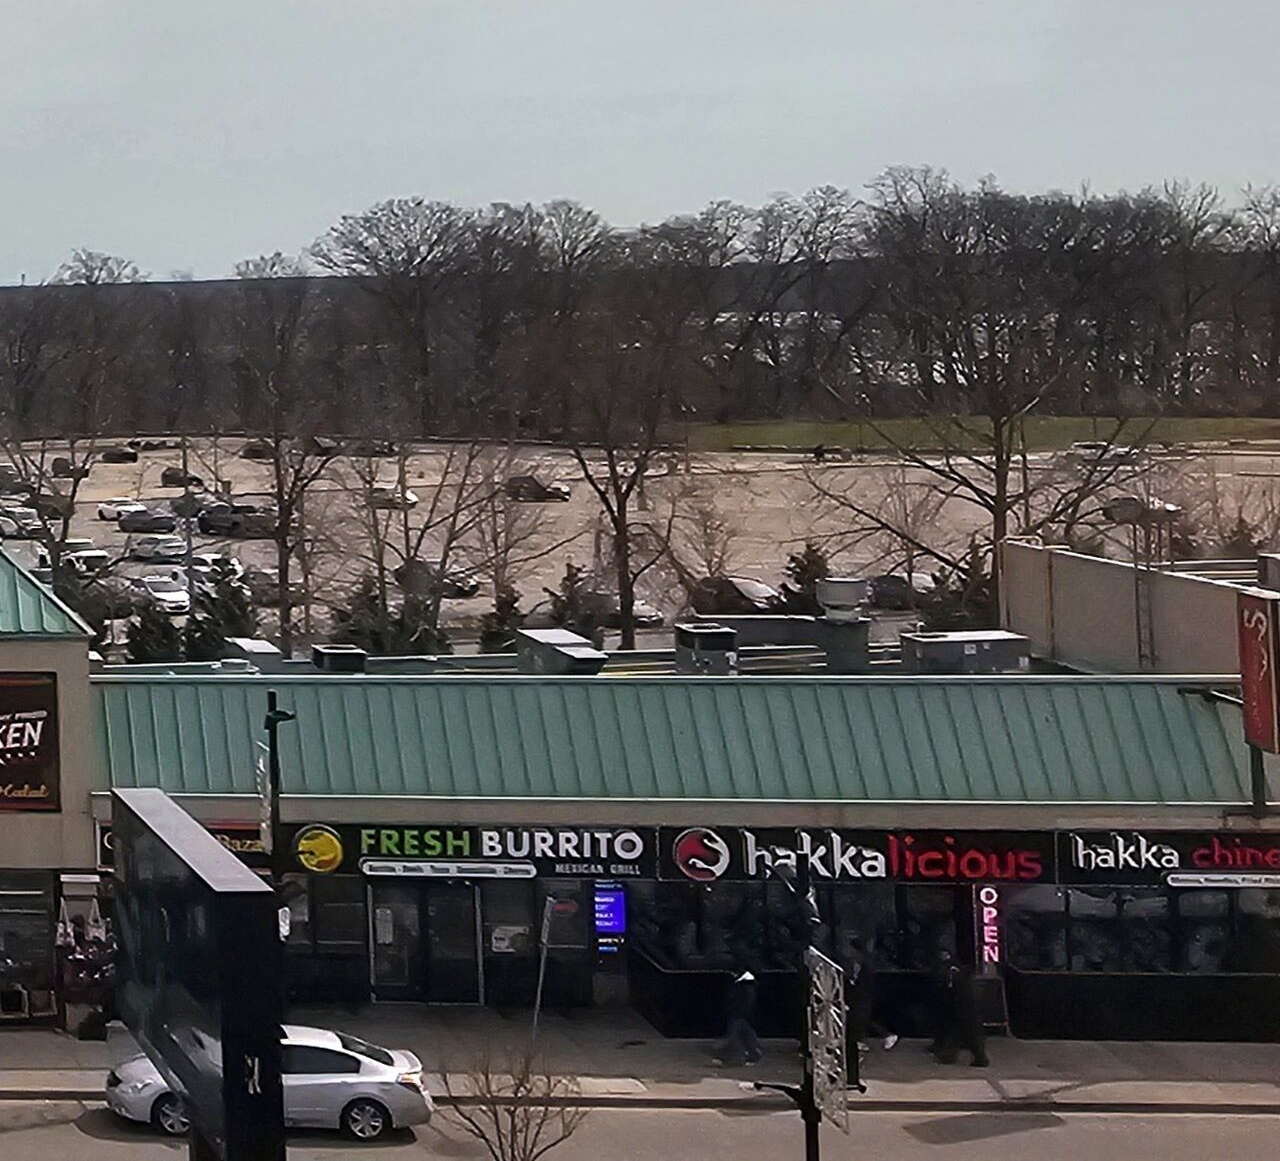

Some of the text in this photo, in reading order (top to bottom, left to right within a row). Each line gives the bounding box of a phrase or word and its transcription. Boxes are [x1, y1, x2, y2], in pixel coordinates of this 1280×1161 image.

[360, 828, 644, 860] FRESH BURRITO
[1070, 832, 1180, 870] hakka
[555, 863, 641, 875] MEXICAN GRILL
[978, 886, 999, 963] OPEN
